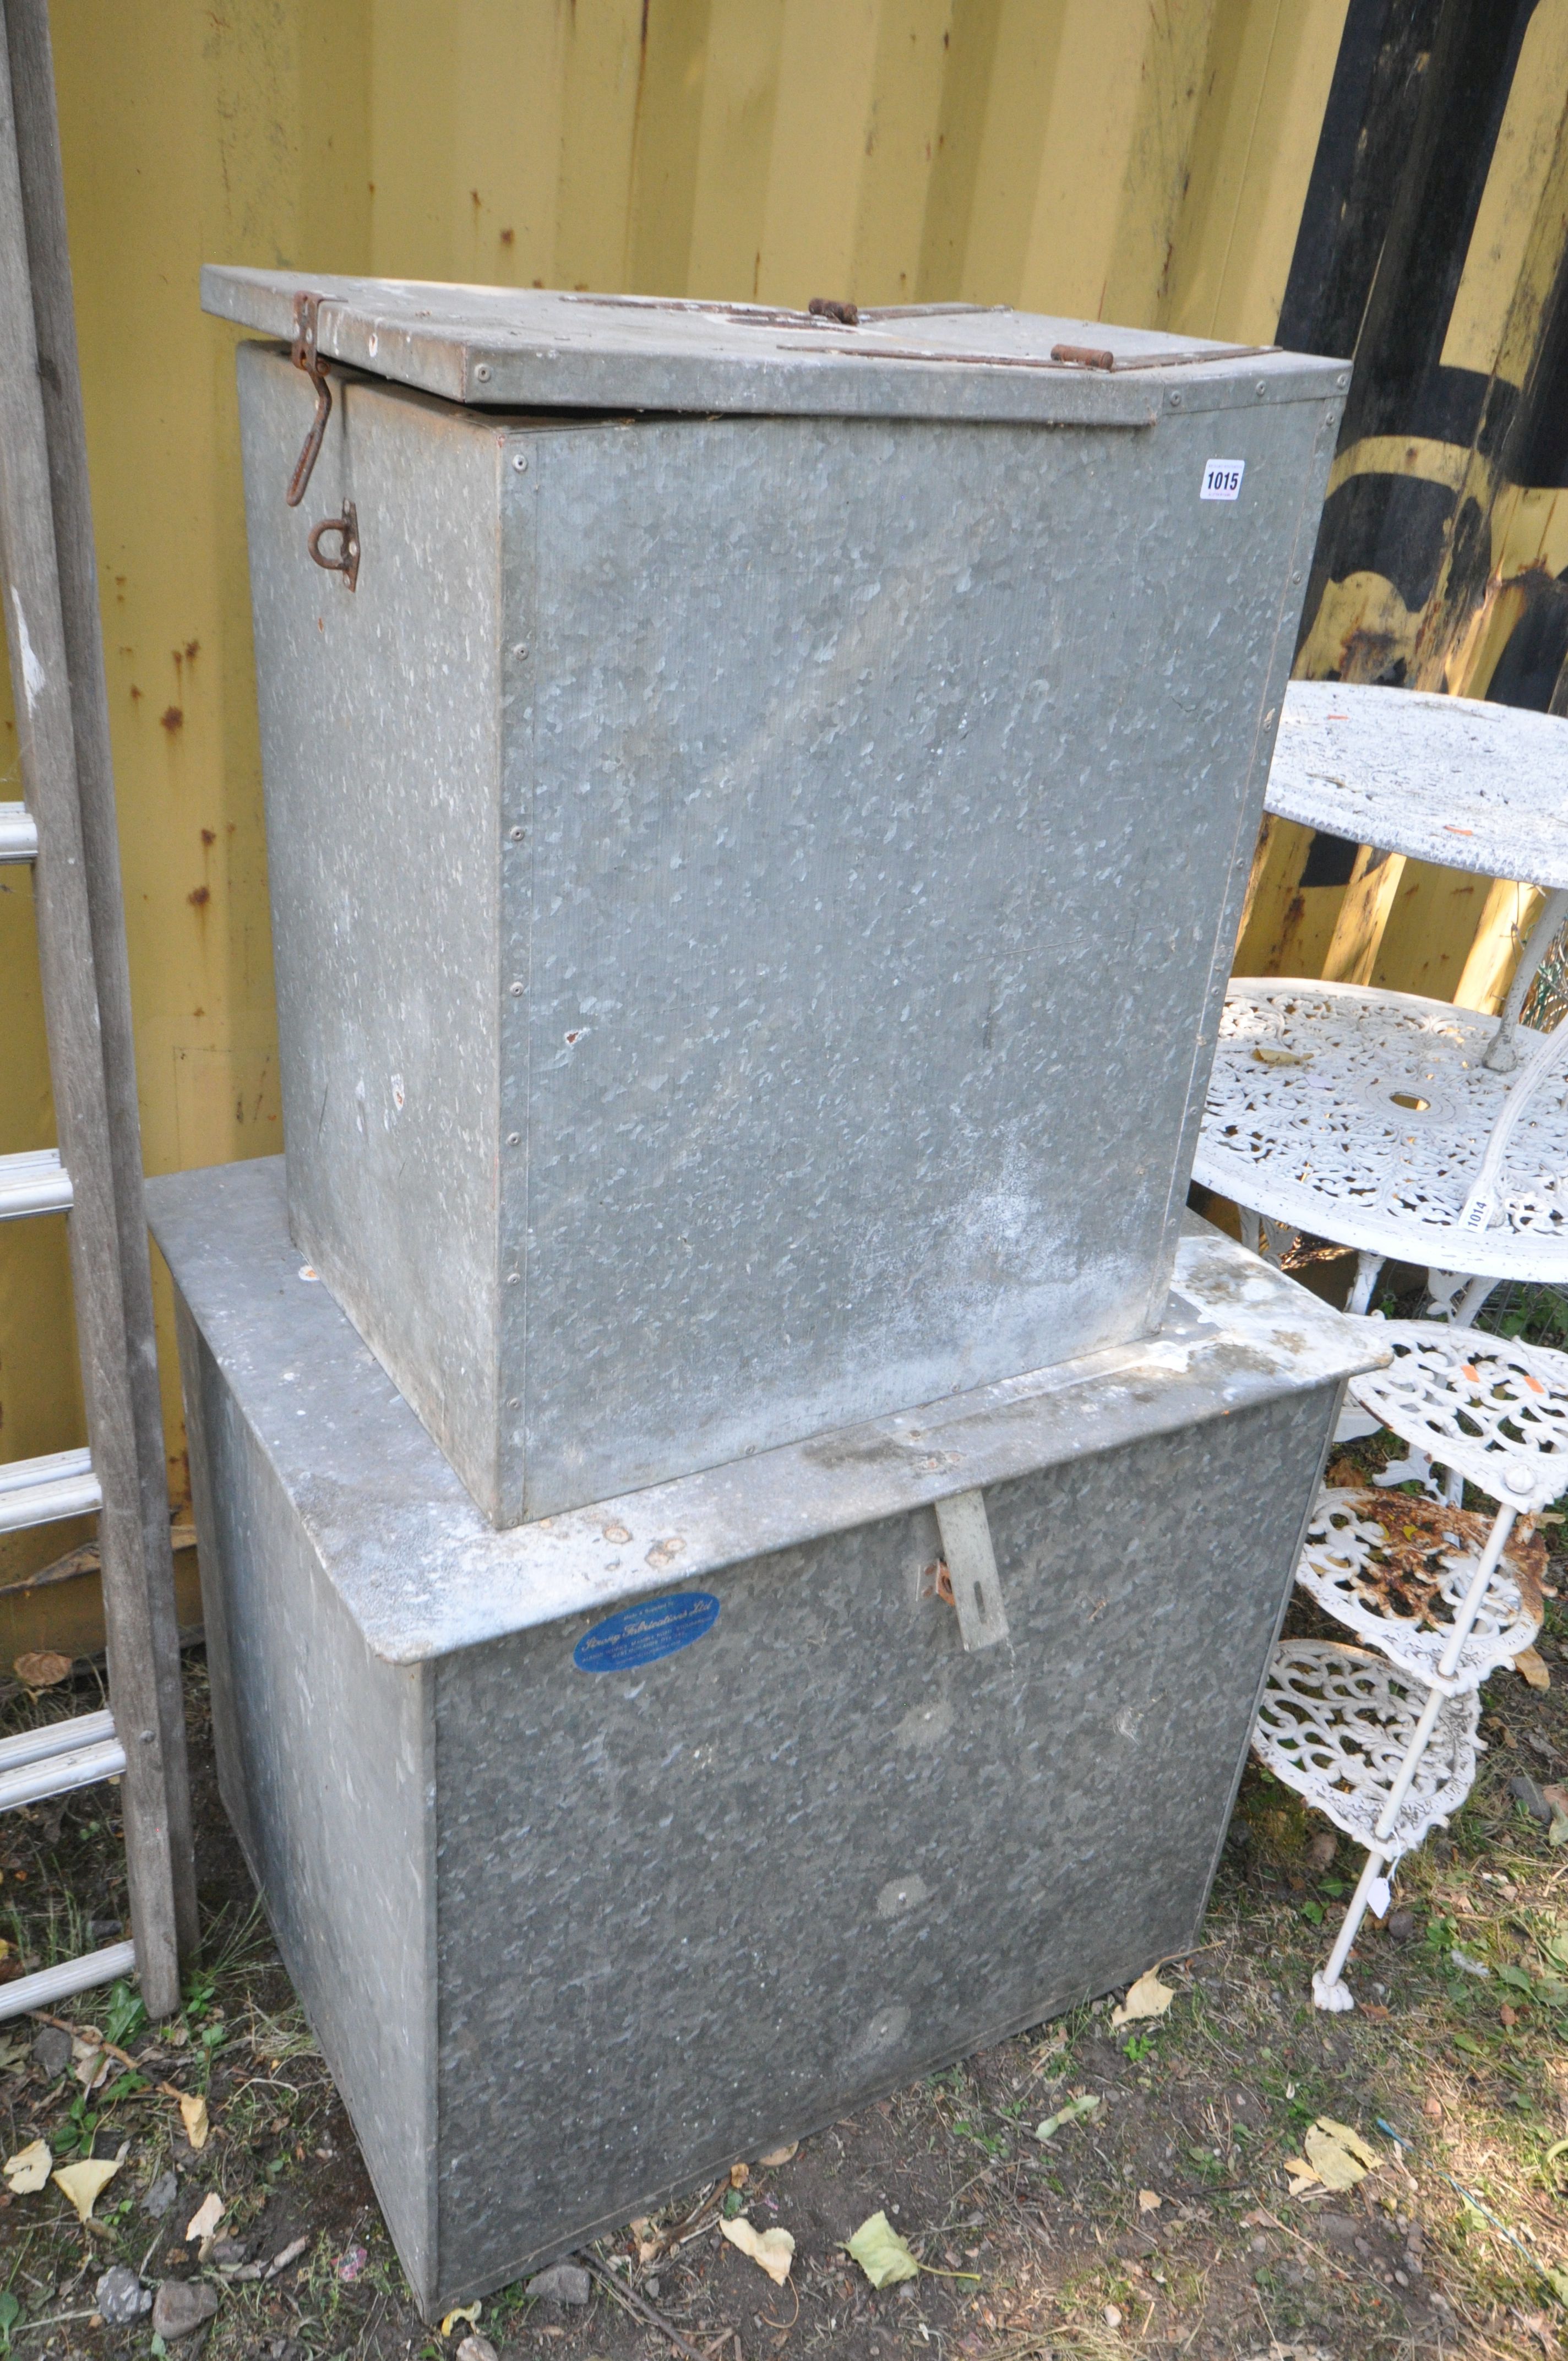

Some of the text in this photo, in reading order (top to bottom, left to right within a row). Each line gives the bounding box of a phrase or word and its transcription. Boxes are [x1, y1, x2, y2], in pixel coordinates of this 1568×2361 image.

[1208, 471, 1239, 491] 1015
[1467, 1201, 1487, 1227] 1014
[622, 1609, 688, 1638] Fabrications
[689, 1598, 714, 1615] Ltd
